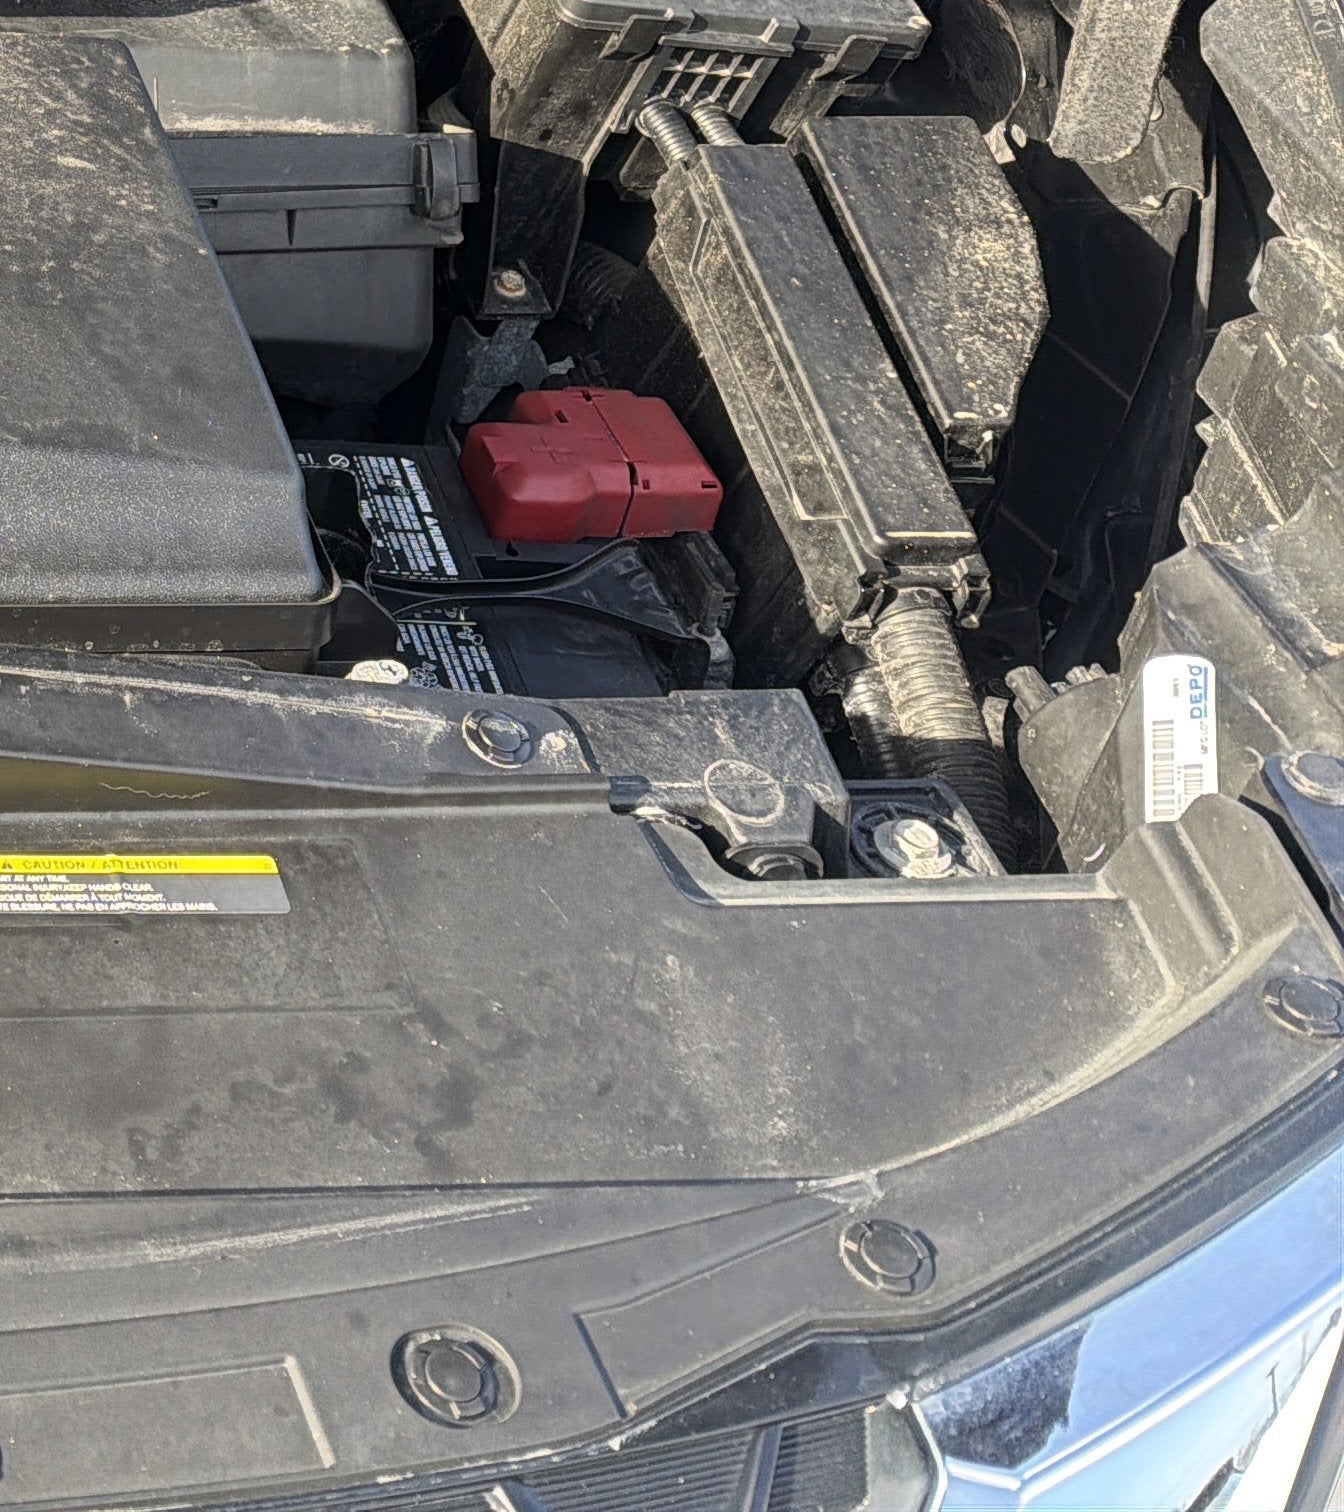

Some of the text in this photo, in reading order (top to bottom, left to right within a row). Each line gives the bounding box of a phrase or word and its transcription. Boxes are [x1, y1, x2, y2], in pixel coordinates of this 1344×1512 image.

[1187, 664, 1203, 719] DEPO
[22, 861, 86, 870] CAUTION
[101, 860, 179, 870] ATTENTION
[98, 893, 123, 901] TOUT
